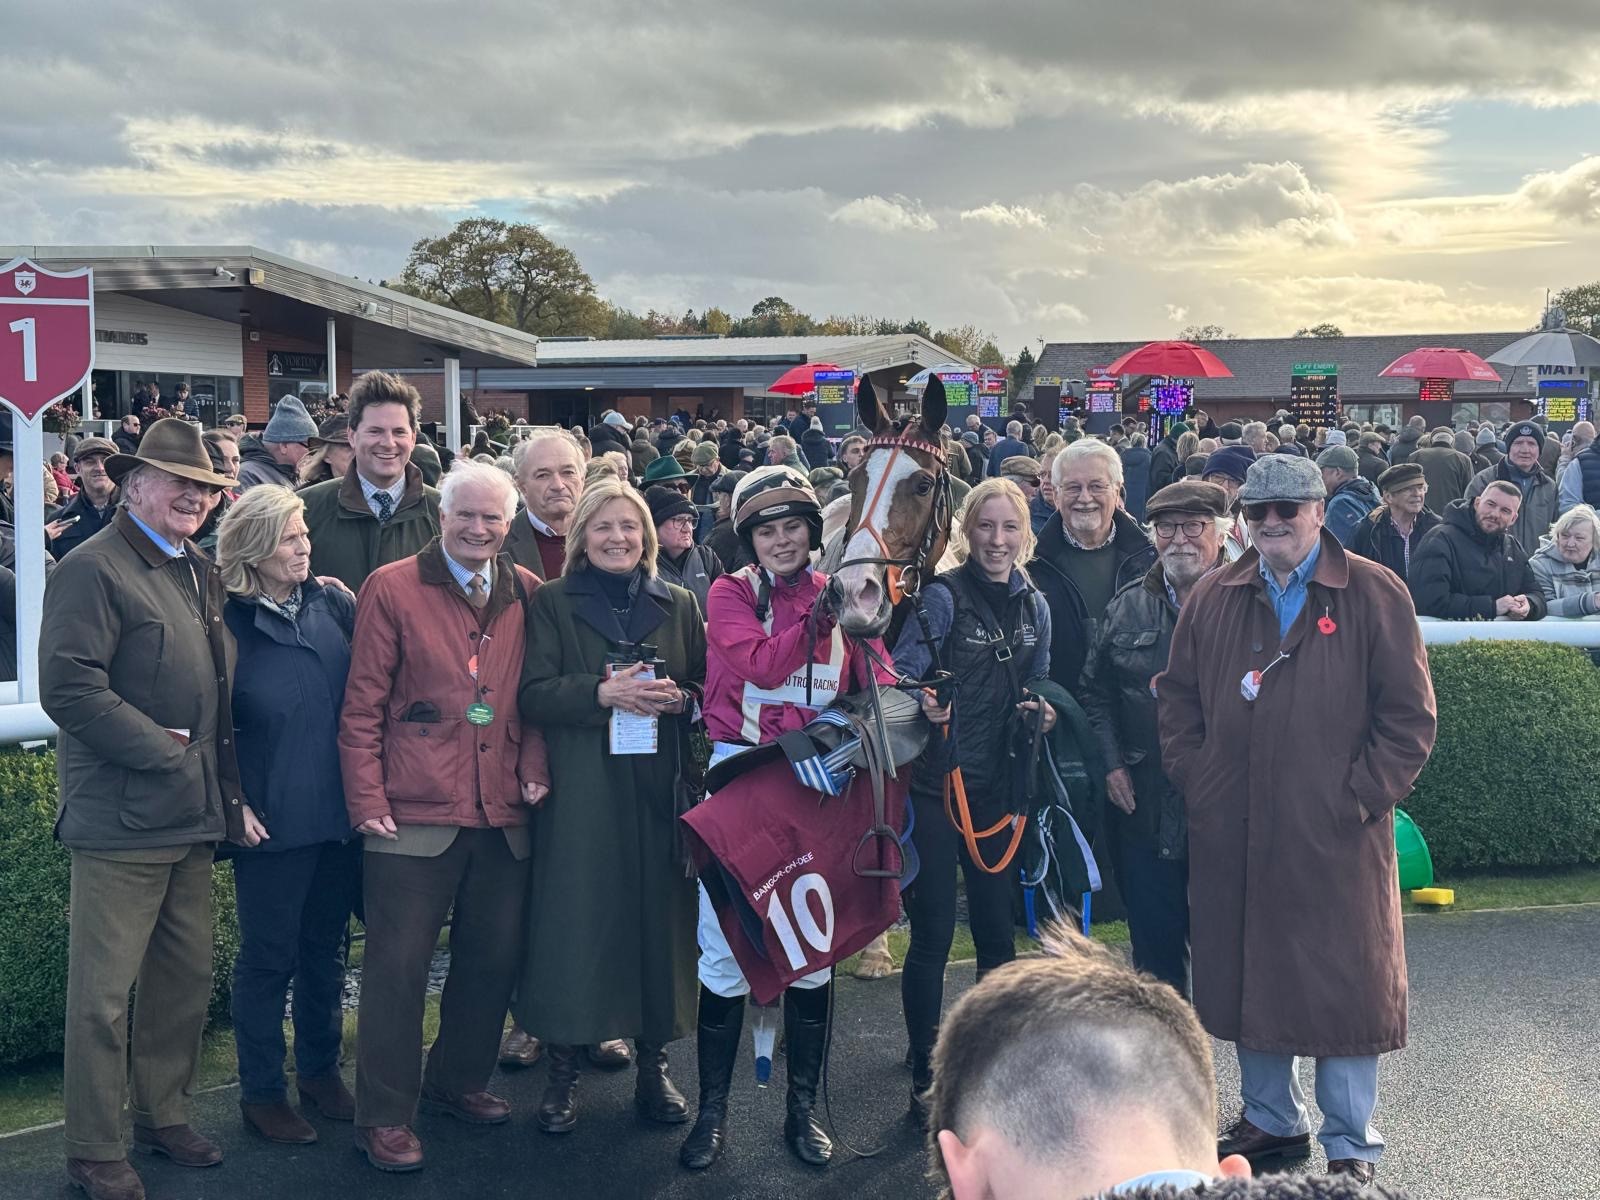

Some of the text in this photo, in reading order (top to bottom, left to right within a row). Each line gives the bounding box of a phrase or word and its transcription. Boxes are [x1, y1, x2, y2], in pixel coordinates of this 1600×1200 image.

[9, 317, 37, 381] 1
[793, 675, 808, 688] TRO
[813, 678, 838, 691] RACING
[753, 851, 814, 902] BANGOR-ON-DEE
[767, 872, 834, 971] 10
